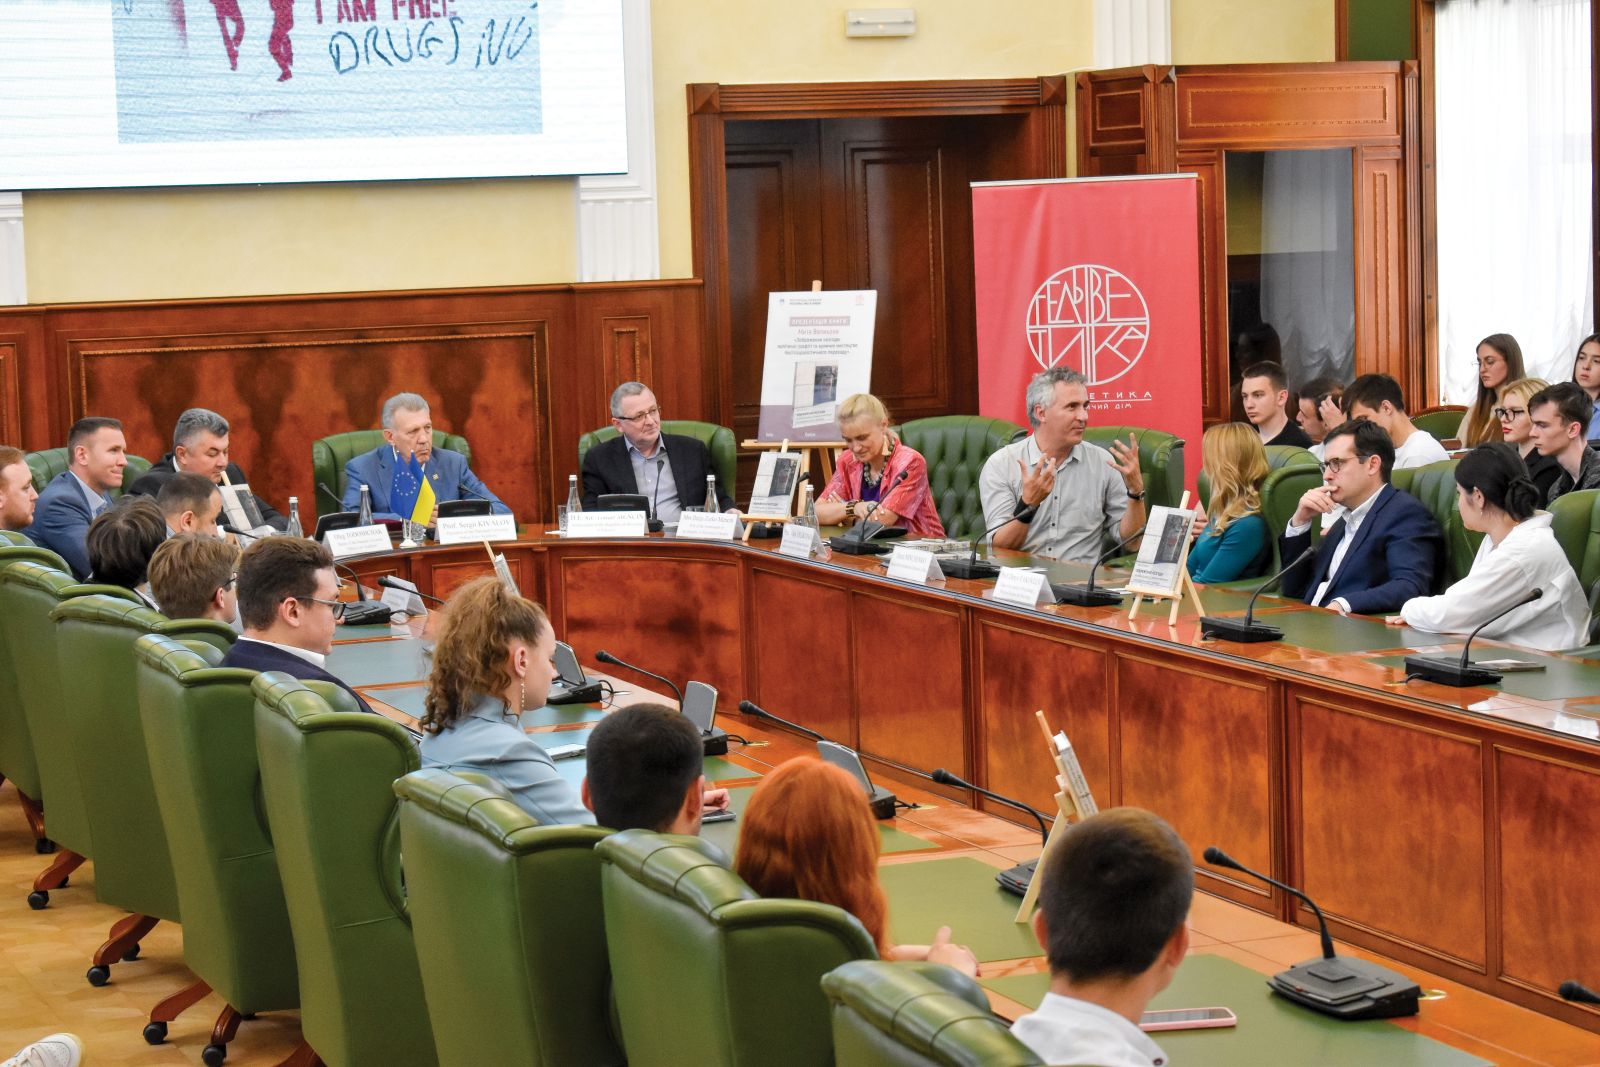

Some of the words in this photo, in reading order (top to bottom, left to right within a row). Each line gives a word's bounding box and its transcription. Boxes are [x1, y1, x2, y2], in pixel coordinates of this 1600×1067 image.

[337, 0, 377, 23] AM
[329, 16, 464, 74] DRUGS
[1089, 391, 1152, 400] ЕТИКА
